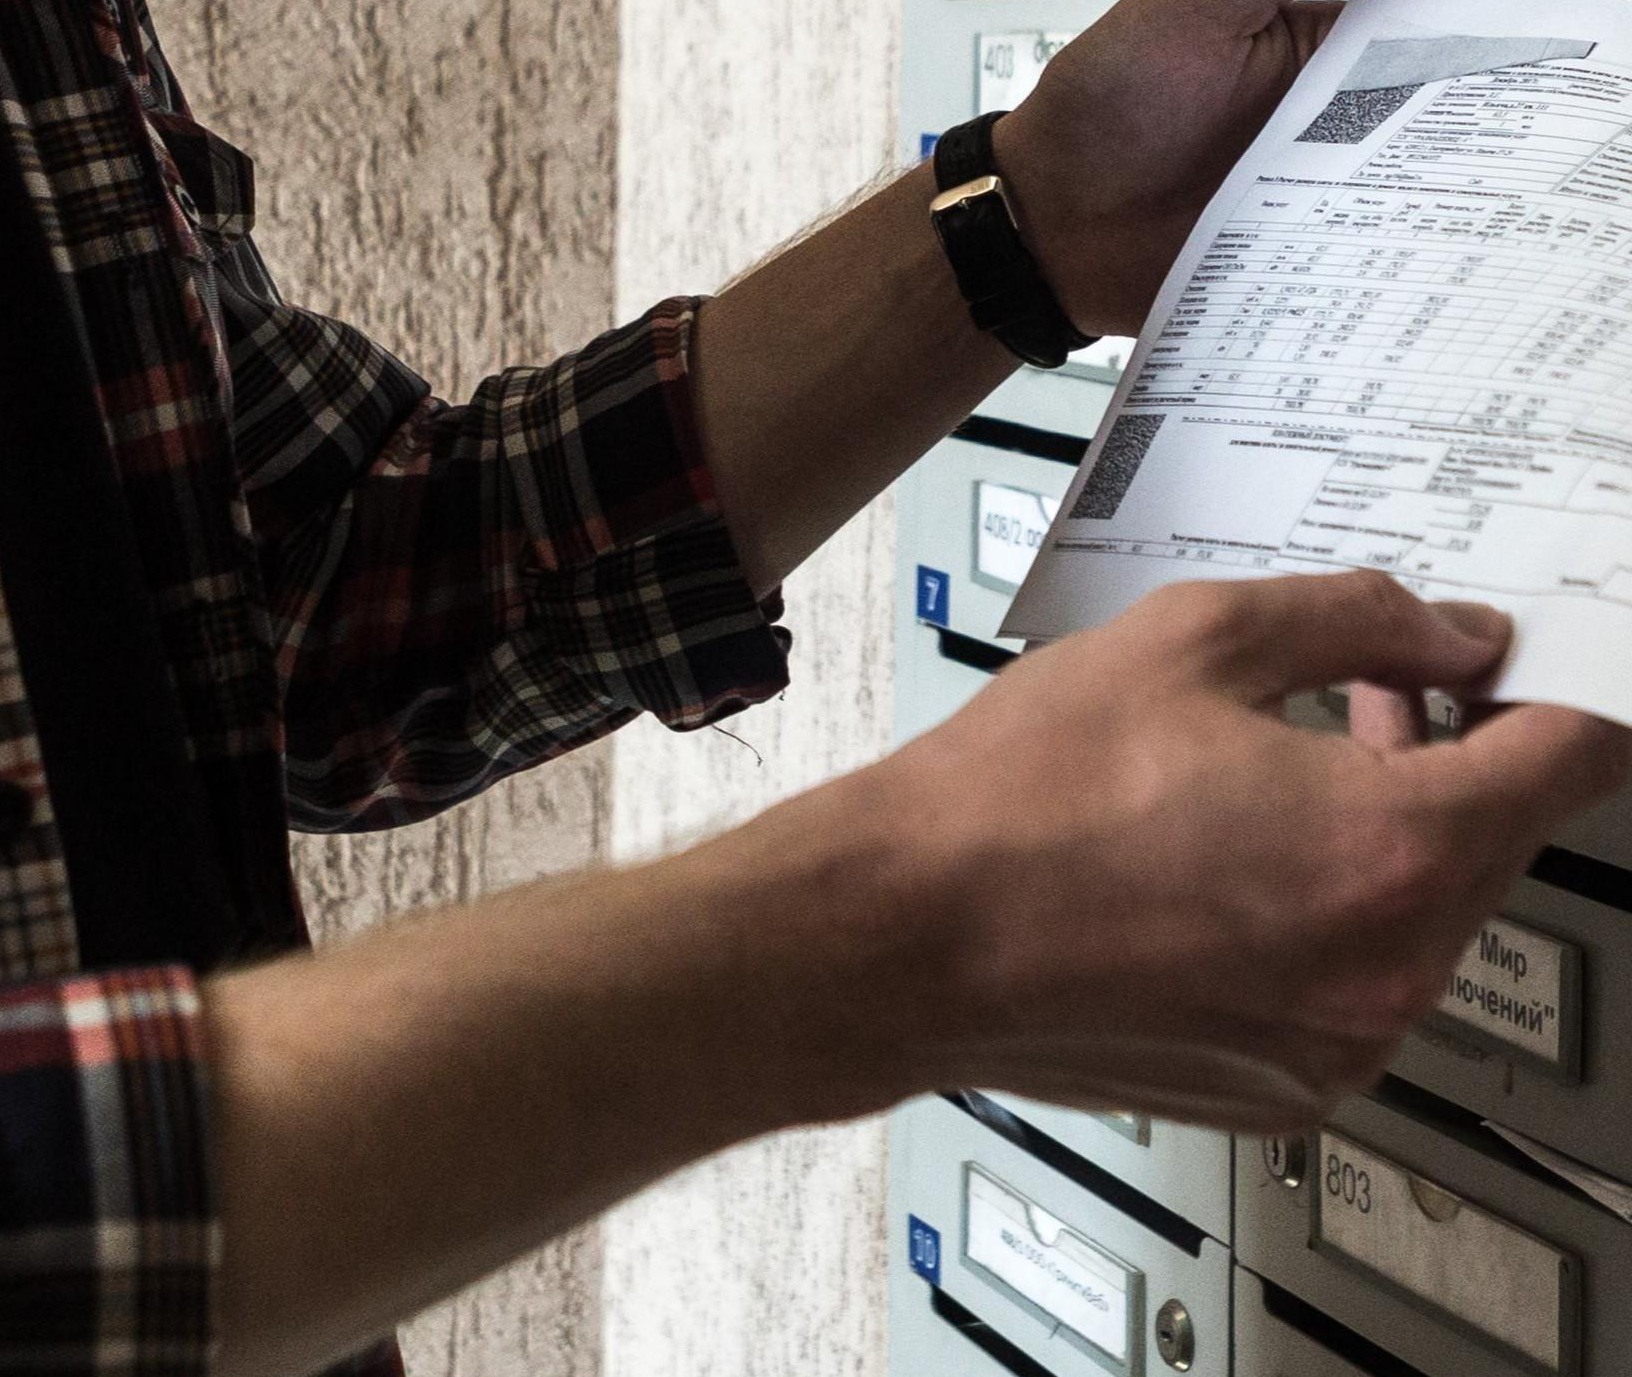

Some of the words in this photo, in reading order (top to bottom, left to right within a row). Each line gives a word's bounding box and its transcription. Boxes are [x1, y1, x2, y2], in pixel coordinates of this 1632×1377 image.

[924, 575, 940, 612] 7
[1479, 929, 1528, 983] Мир
[1326, 1153, 1372, 1214] 803
